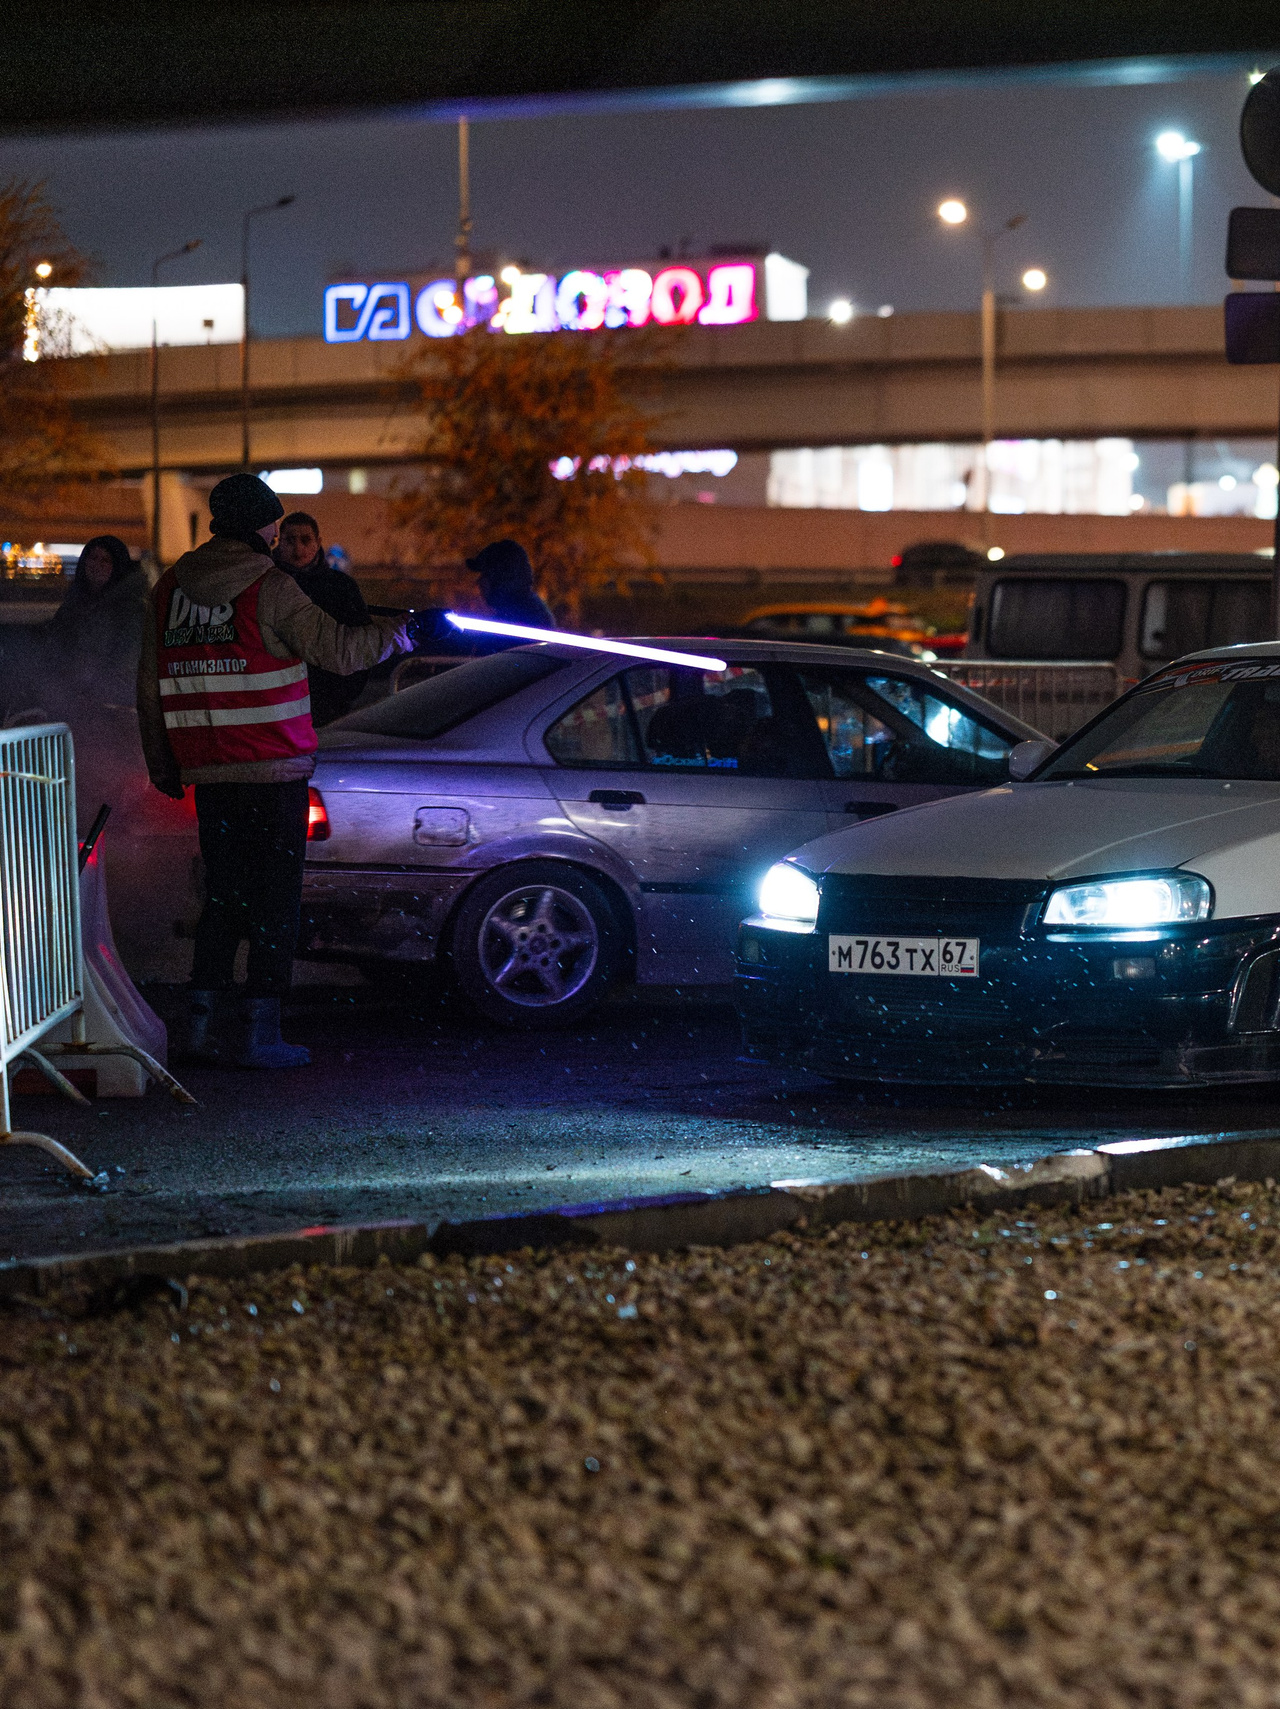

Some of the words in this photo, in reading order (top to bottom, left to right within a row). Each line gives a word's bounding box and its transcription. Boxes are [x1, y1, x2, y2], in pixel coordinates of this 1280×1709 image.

[167, 658, 247, 676] ОРГАНИЗАТОР
[942, 941, 967, 965] 67
[941, 964, 960, 973] RUS
